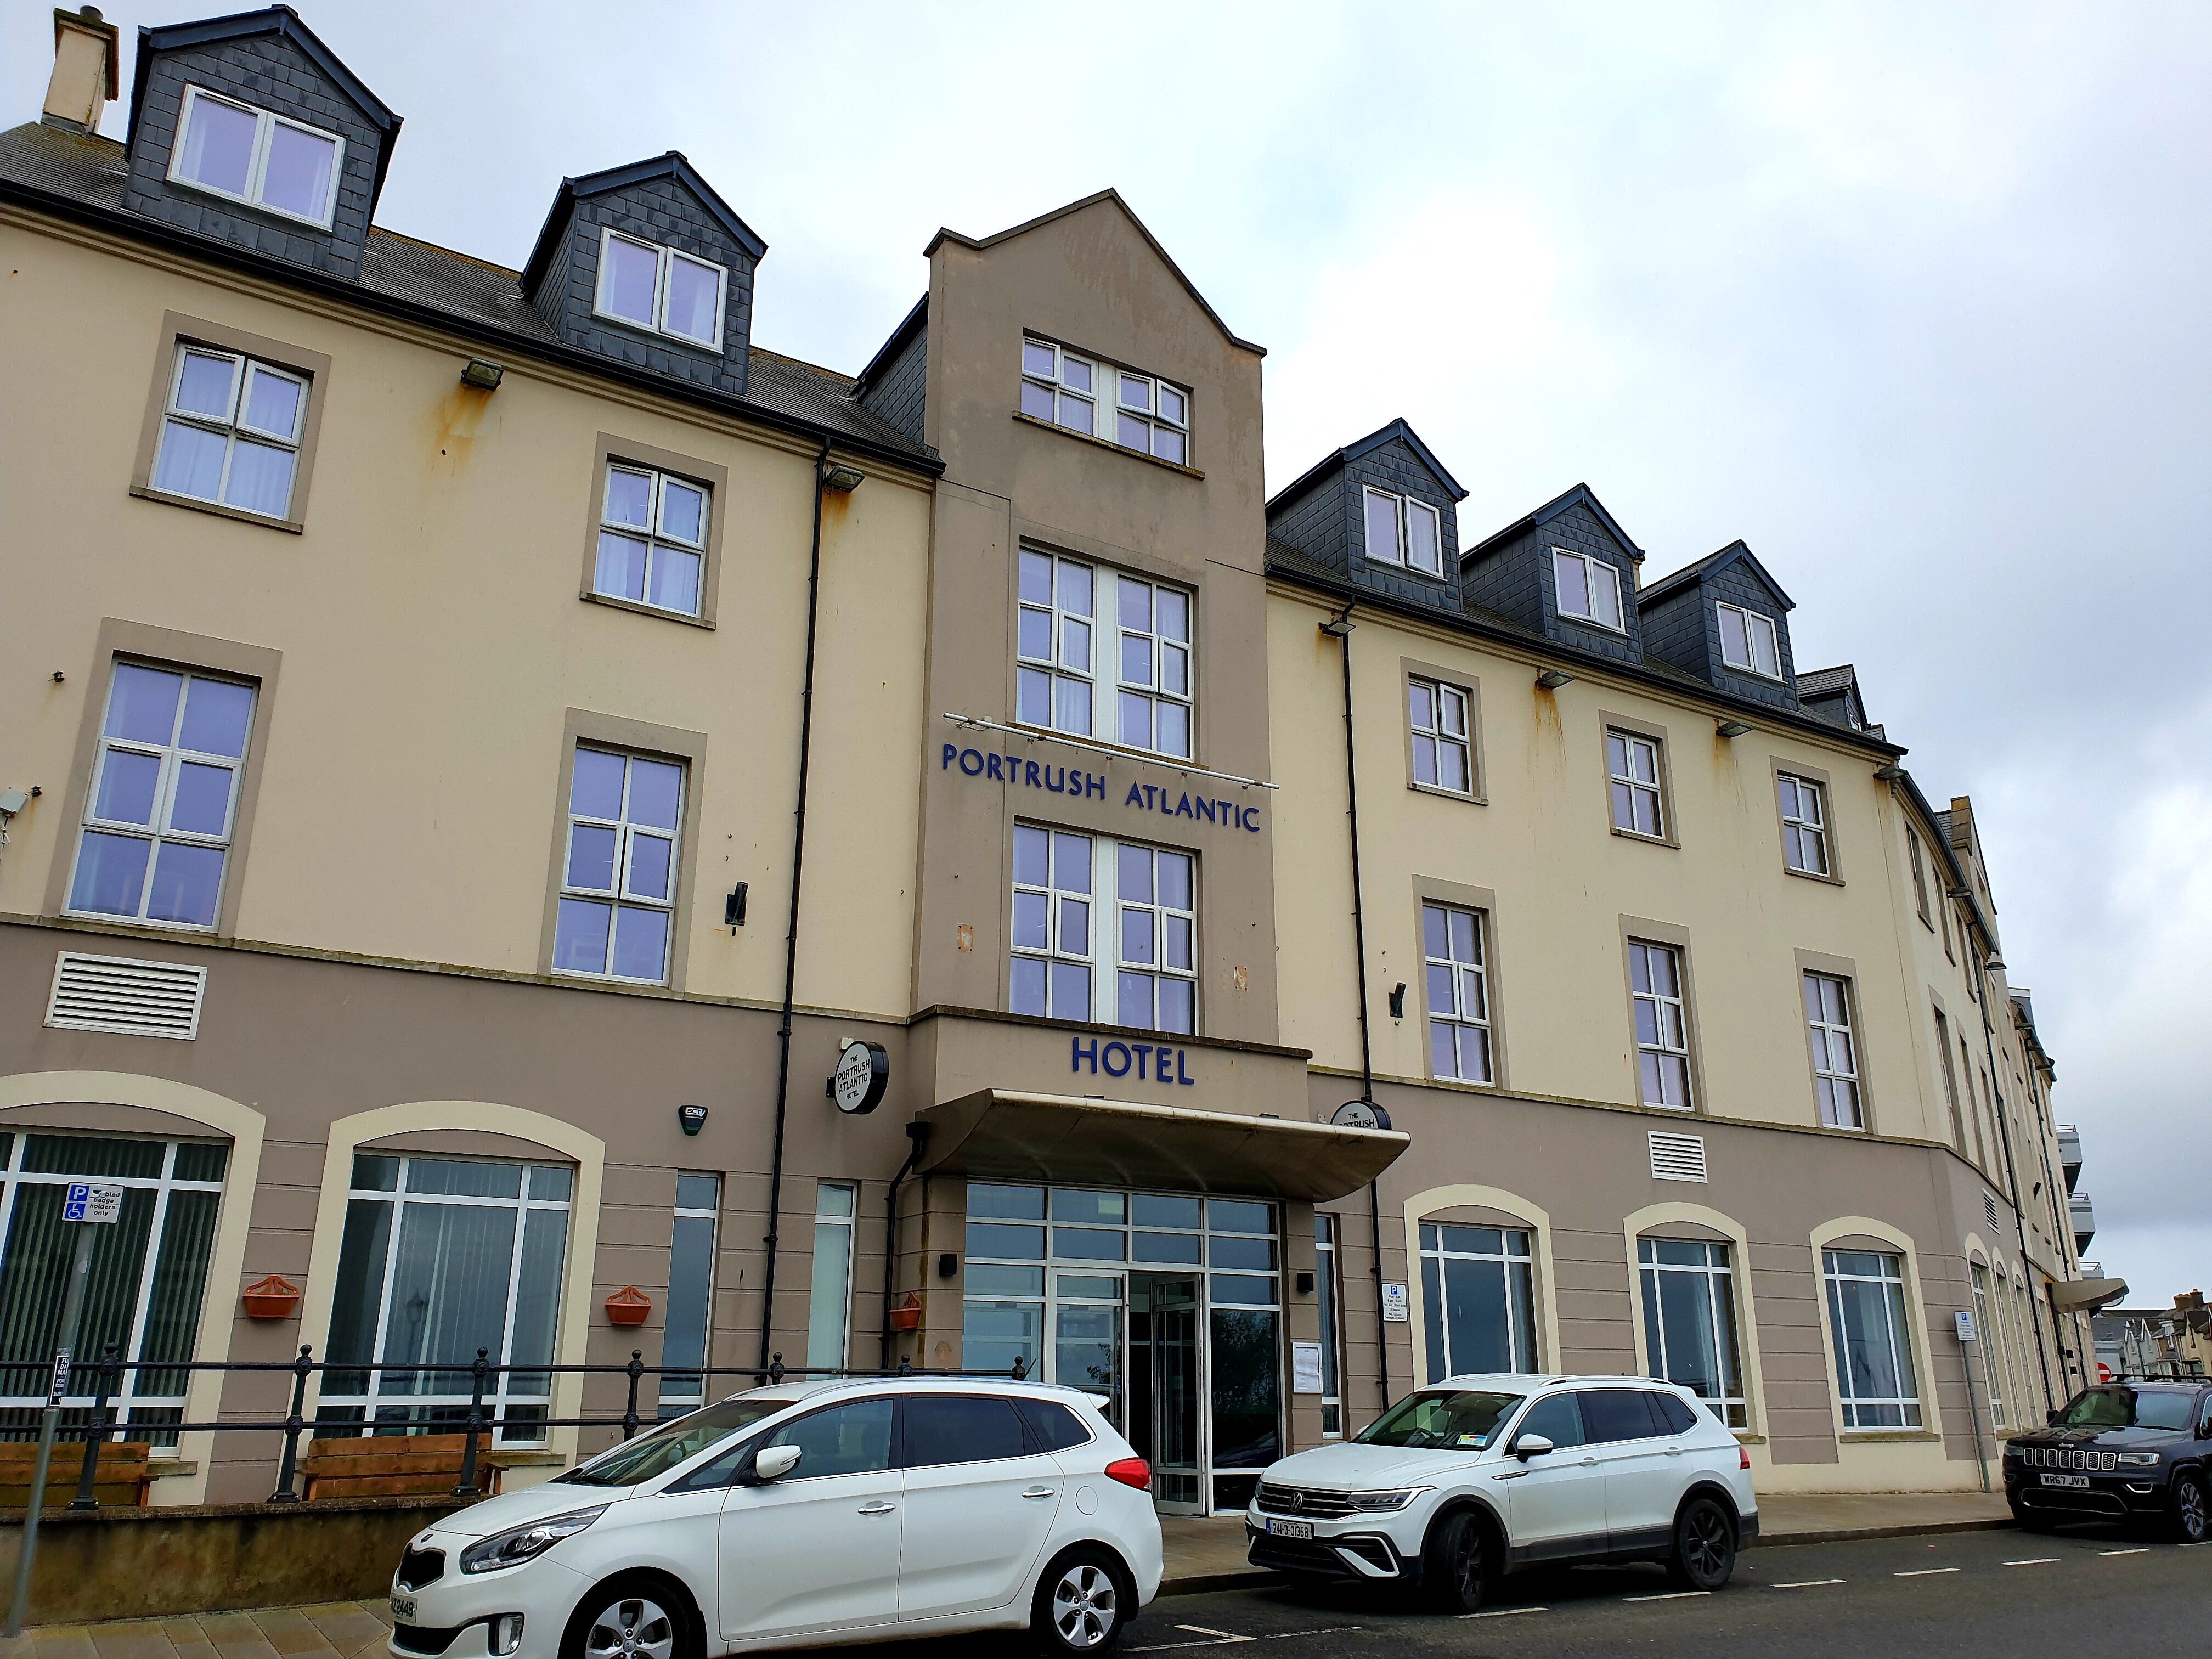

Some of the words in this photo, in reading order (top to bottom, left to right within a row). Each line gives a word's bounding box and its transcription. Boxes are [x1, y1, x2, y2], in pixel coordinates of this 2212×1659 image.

[943, 744, 1105, 799] PORTRUSH
[1126, 782, 1260, 832] ATLANTIC
[850, 1054, 858, 1064] THE
[1073, 1037, 1195, 1085] HOTEL
[838, 1058, 870, 1082] PORTRUSH
[839, 1072, 868, 1094] ATLANTIC
[846, 1090, 859, 1101] HOTEL
[1339, 1118, 1375, 1128] TRUSH
[2069, 1477, 2086, 1486] JVX
[1273, 1522, 1308, 1538] 241-D-31358
